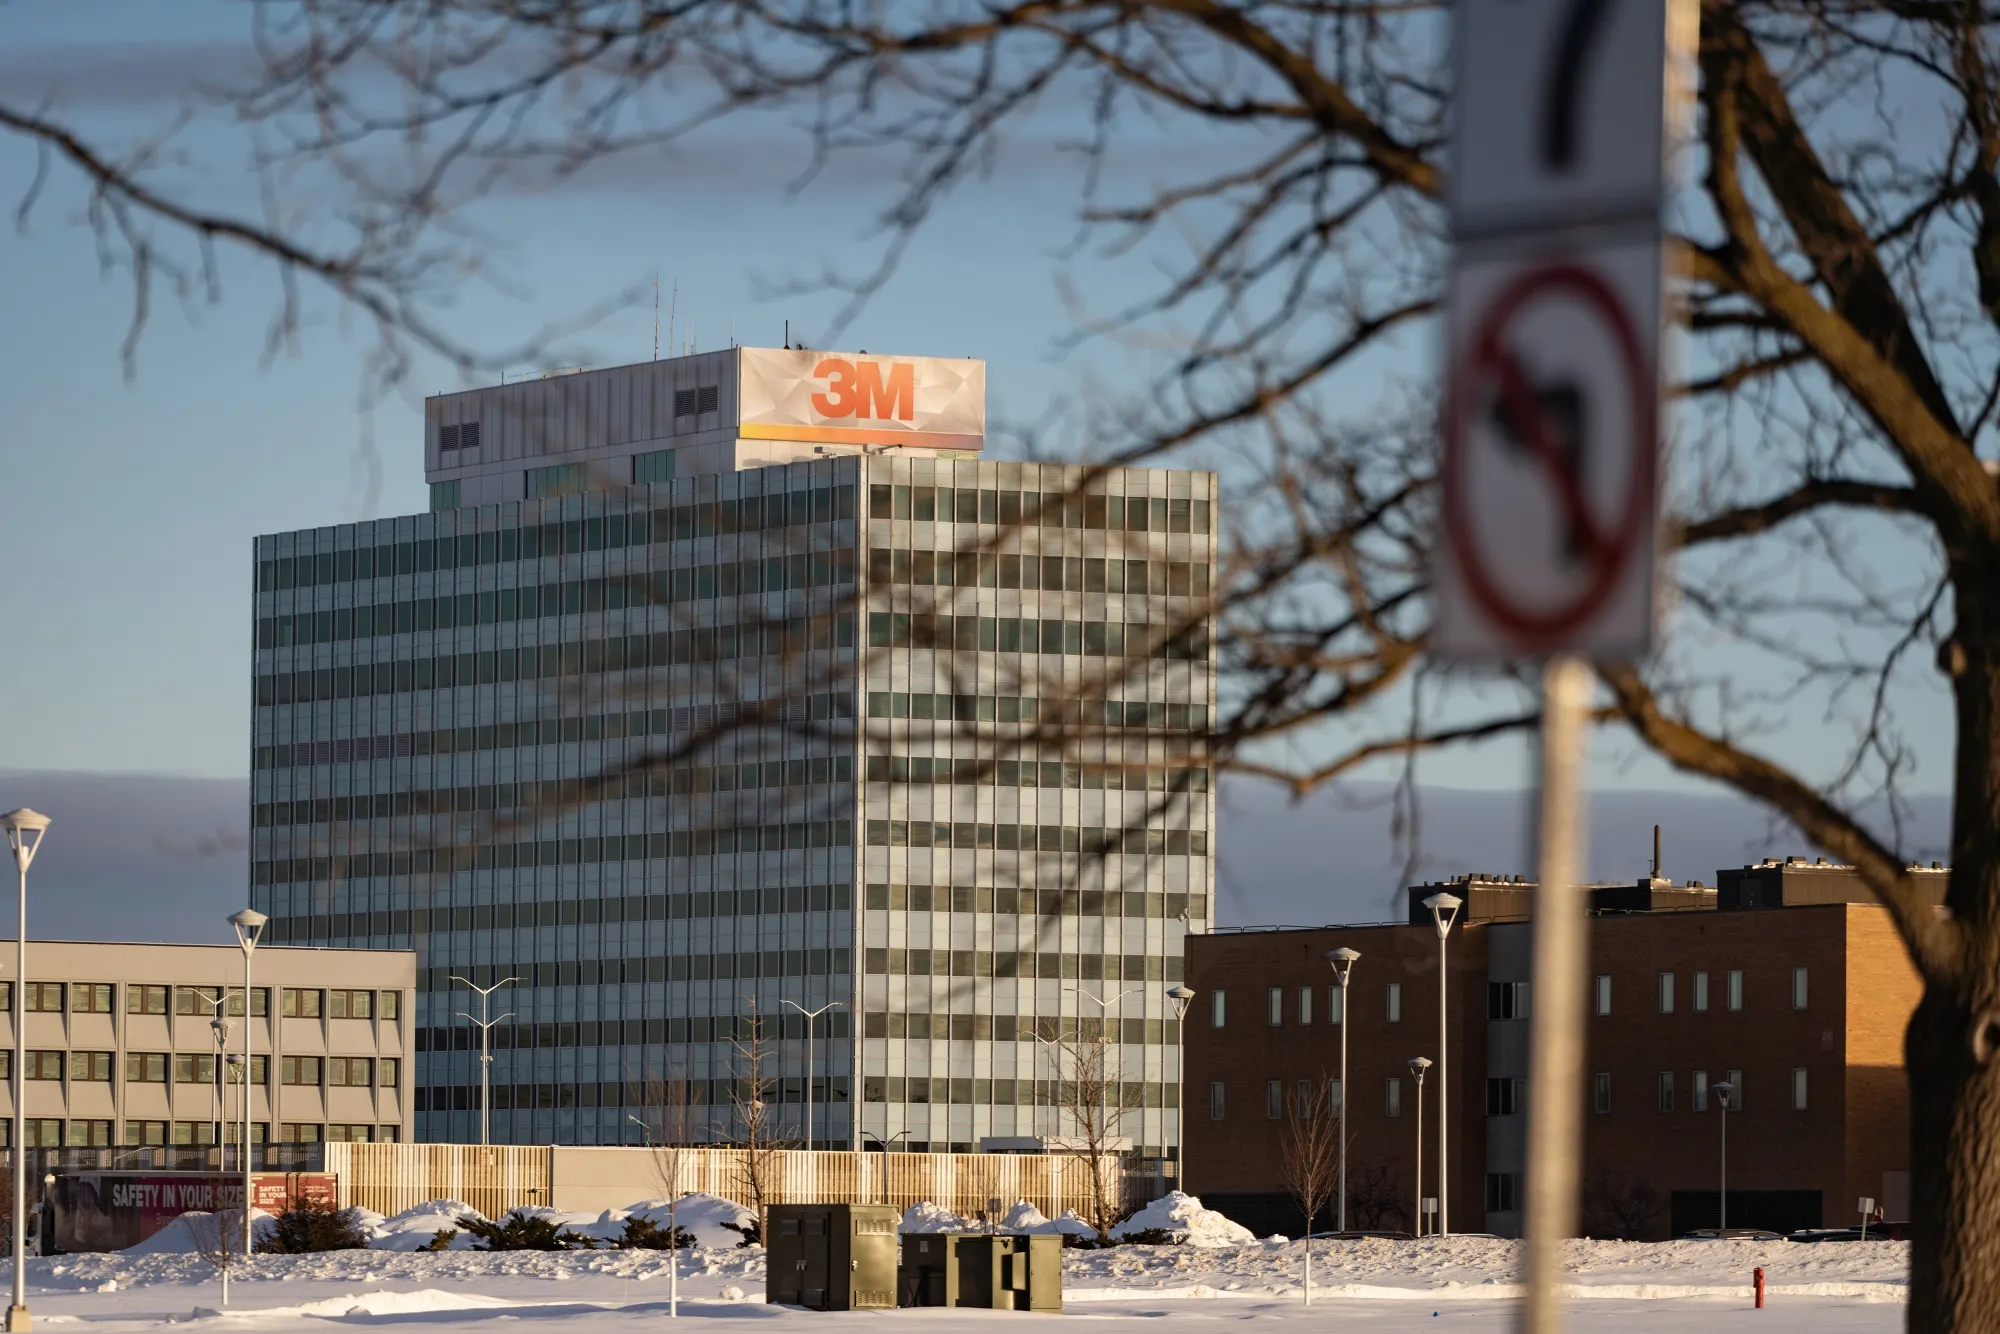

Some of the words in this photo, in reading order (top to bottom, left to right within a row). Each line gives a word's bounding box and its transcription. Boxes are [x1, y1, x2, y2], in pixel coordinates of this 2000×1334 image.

[811, 358, 914, 420] 3M
[112, 1183, 159, 1207] SAFETY
[162, 1184, 175, 1208] IN
[178, 1184, 213, 1208] YOUR
[217, 1185, 244, 1208] SIZE
